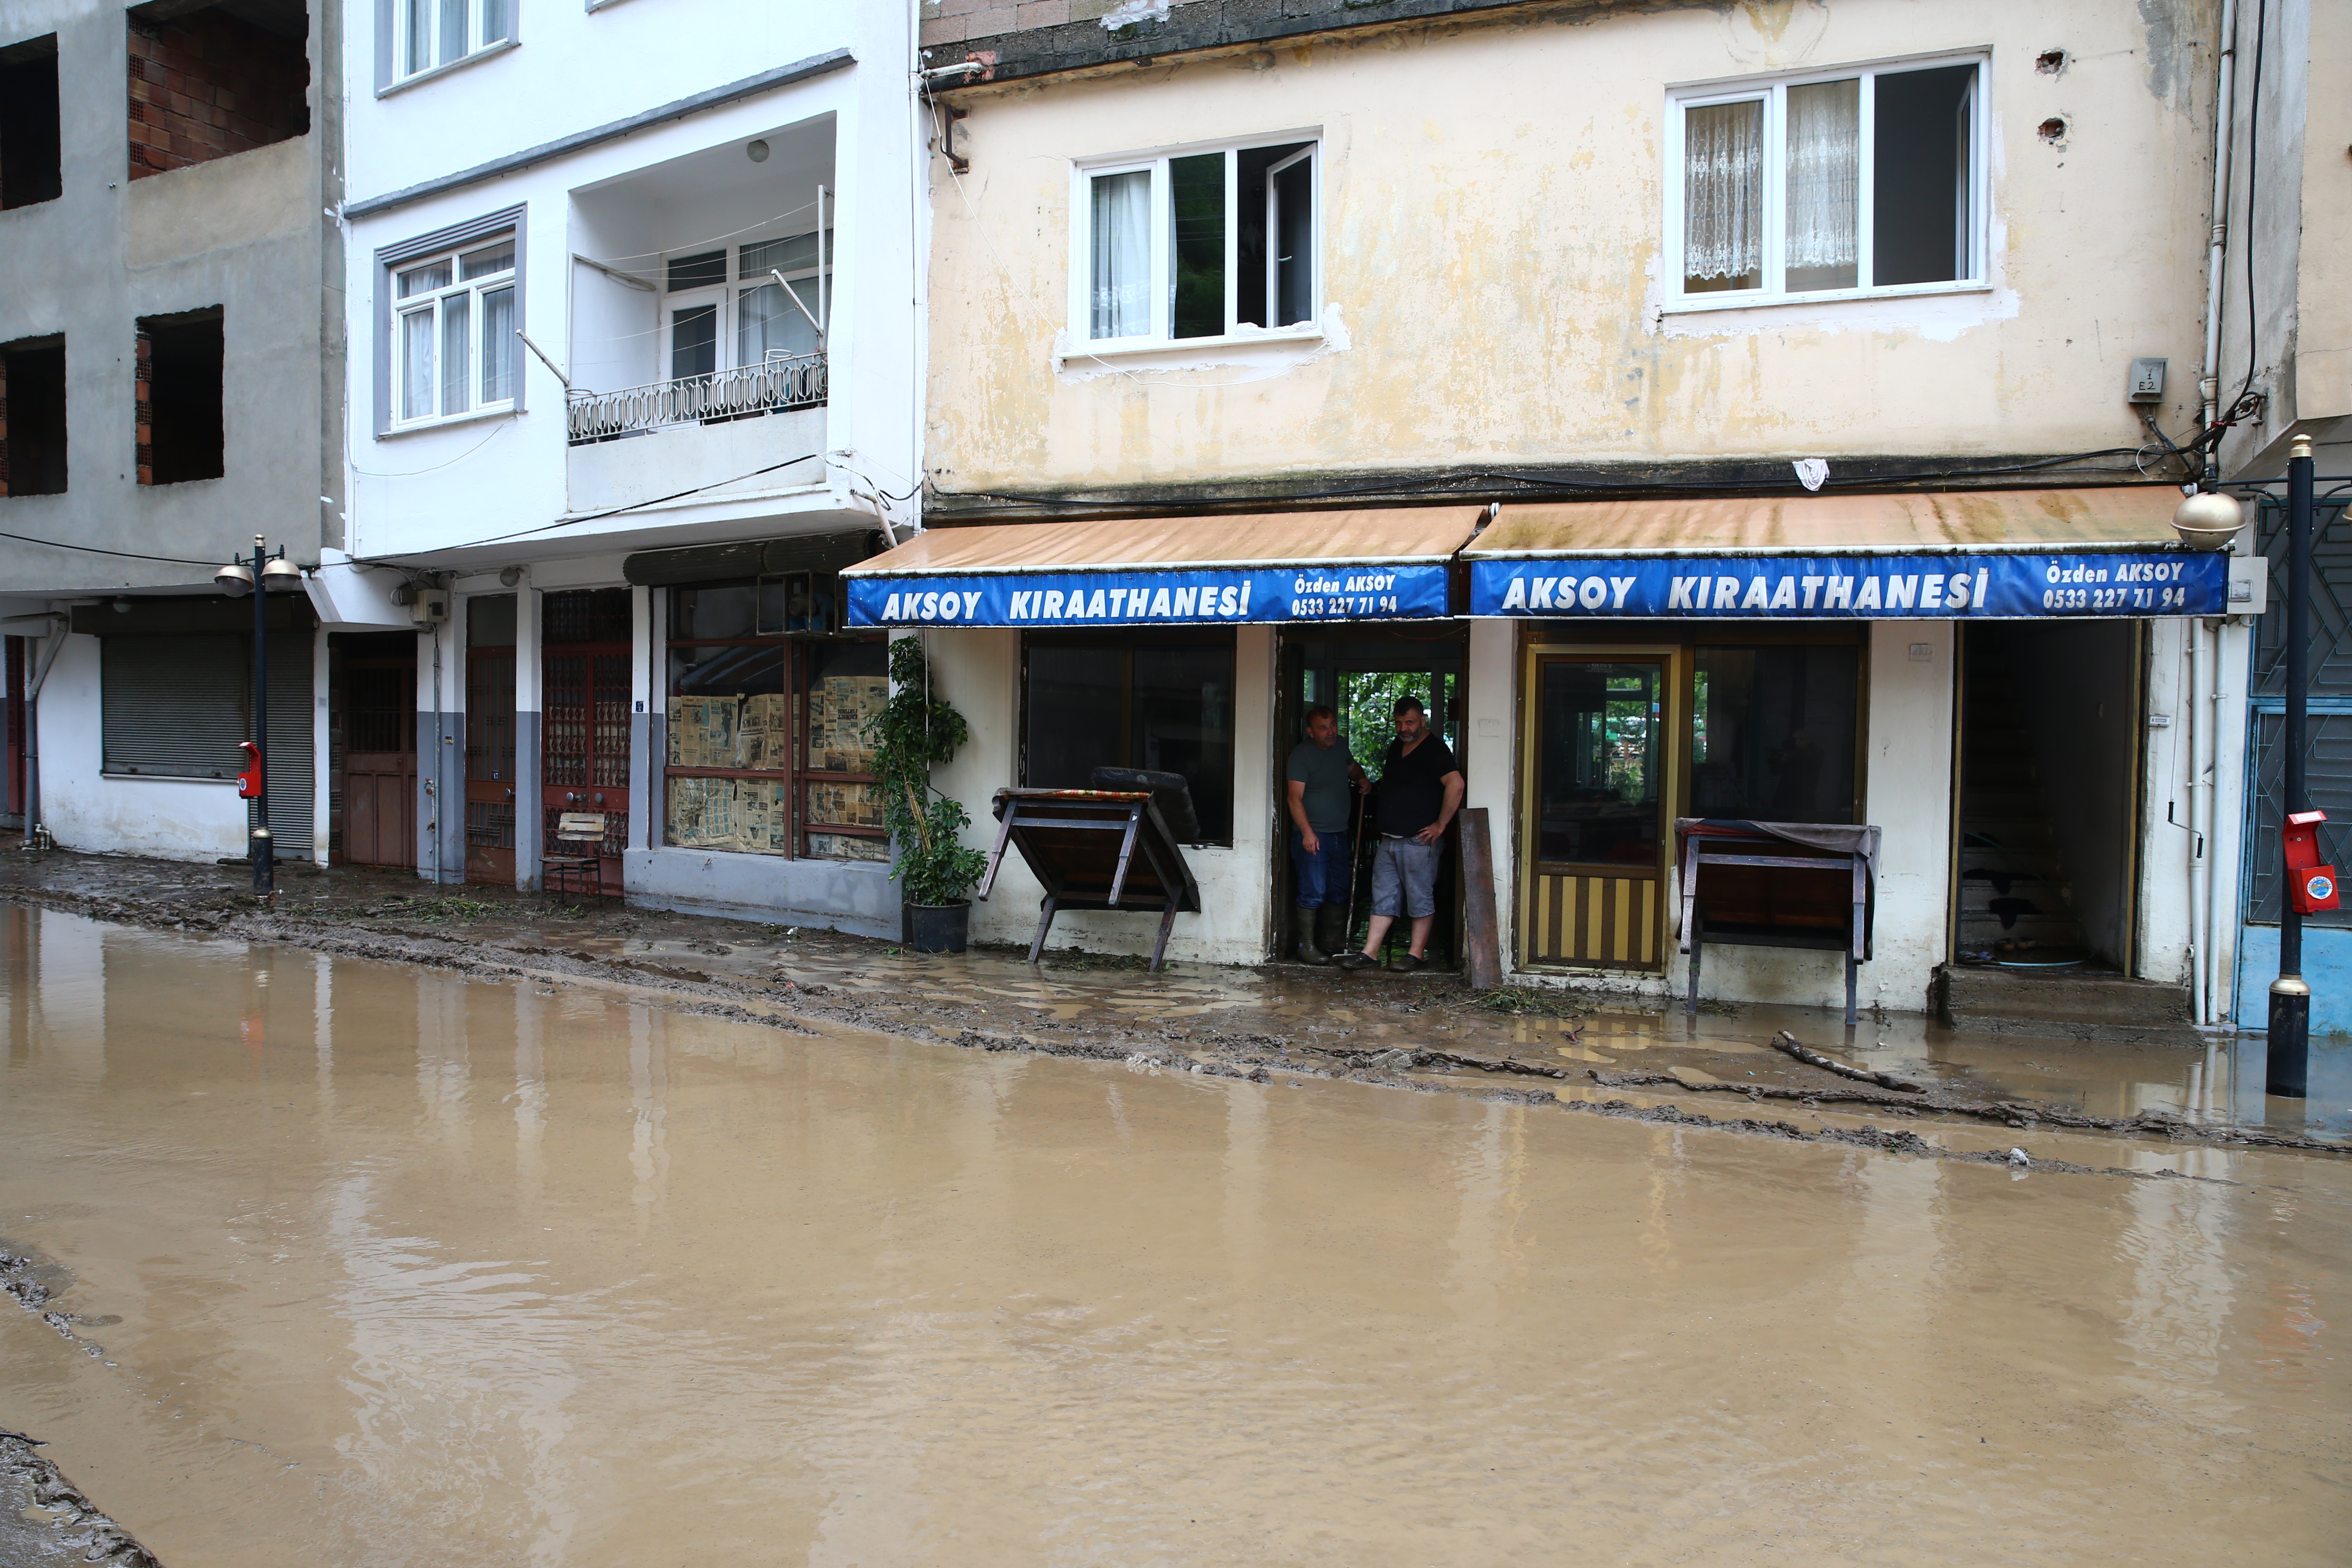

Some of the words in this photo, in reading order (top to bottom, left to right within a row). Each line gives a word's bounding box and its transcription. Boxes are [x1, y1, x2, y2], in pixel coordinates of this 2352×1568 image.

[2046, 560, 2108, 583] Özden
[2115, 563, 2184, 582] AKSOY
[1294, 574, 1340, 594] Özden
[1344, 574, 1396, 592] AKSOY
[1501, 576, 1637, 609] AKSOY
[1668, 567, 1989, 609] KIRAATHANESİ
[881, 591, 983, 621] AKSOY
[1009, 579, 1251, 619] KIRAATHANESİ
[1292, 598, 1323, 616] 0533
[1328, 597, 1355, 614] 227
[1359, 597, 1374, 614] 71
[1380, 596, 1397, 612] 94
[2043, 588, 2087, 608] 0533
[2093, 588, 2128, 608] 227
[2134, 588, 2153, 607] 71
[2162, 587, 2185, 607] 94
